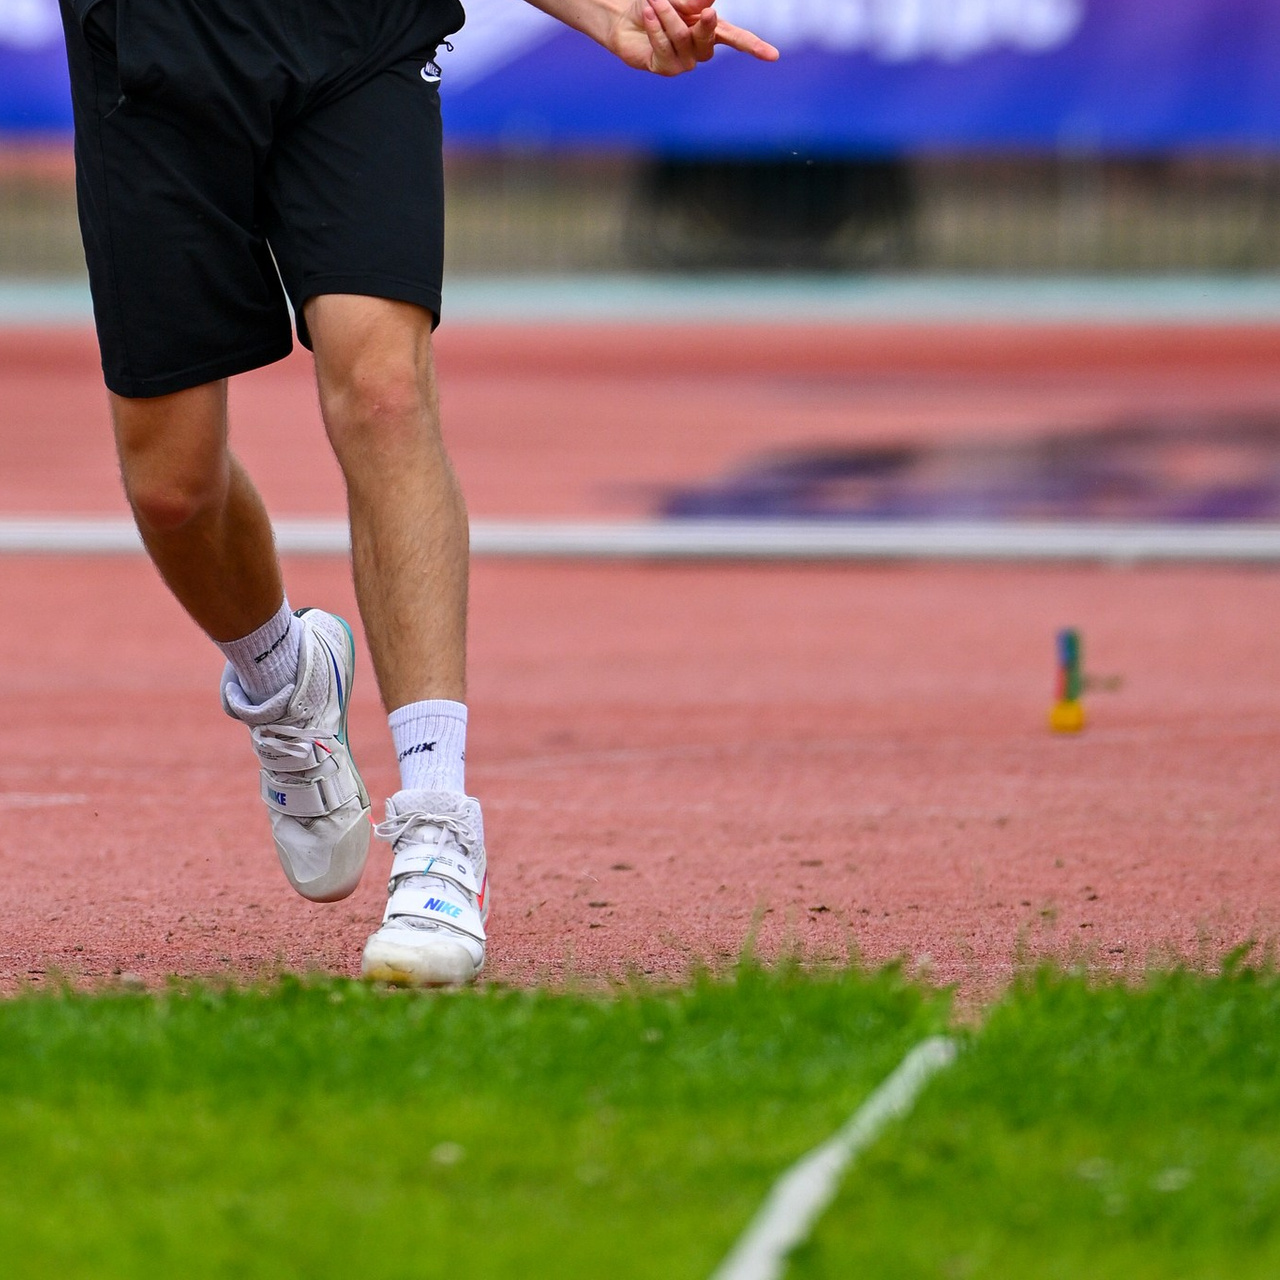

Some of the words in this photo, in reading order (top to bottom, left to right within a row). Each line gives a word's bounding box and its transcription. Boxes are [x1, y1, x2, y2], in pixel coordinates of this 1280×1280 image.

[425, 61, 441, 76] NIKE
[267, 784, 287, 807] NIKE
[423, 897, 463, 918] NIKE
